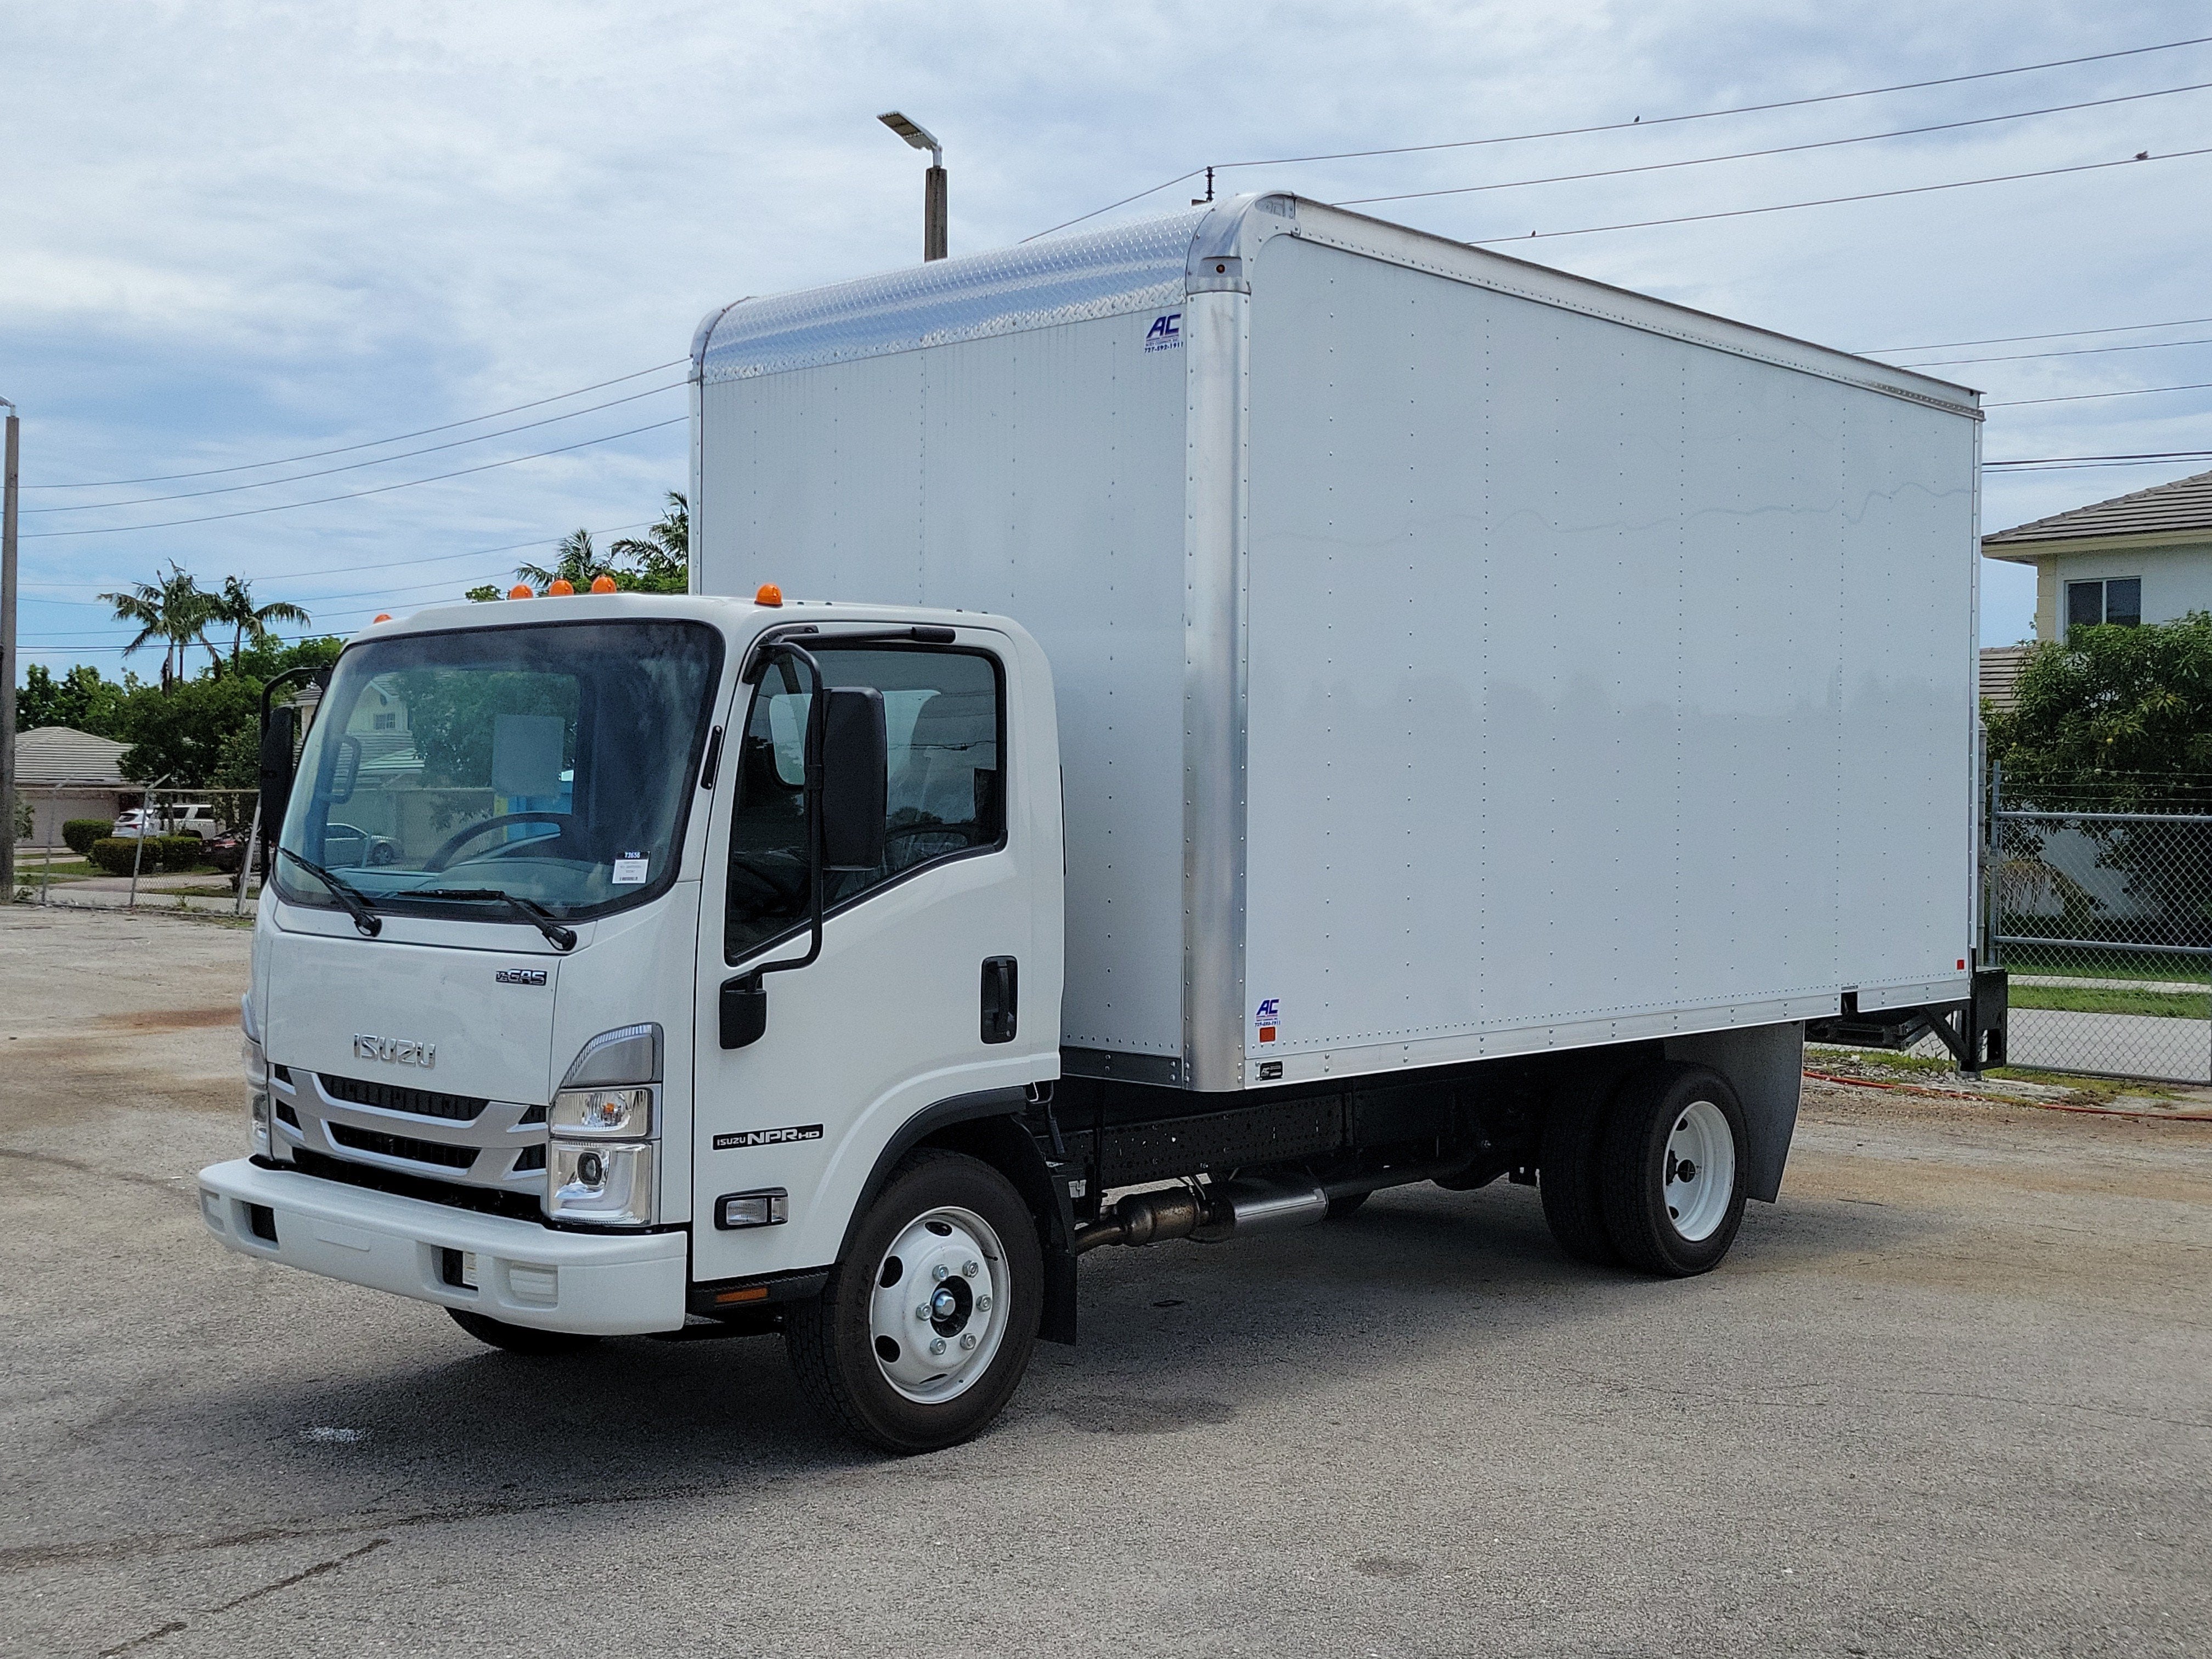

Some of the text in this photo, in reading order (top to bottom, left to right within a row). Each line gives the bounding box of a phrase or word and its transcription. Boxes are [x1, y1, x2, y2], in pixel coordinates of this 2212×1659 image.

[1146, 313, 1182, 339] AC
[507, 969, 545, 985] GAS
[1256, 998, 1279, 1015] AC
[354, 1033, 436, 1069] ISUZU
[717, 1128, 820, 1146] ISUZU NPR HD
